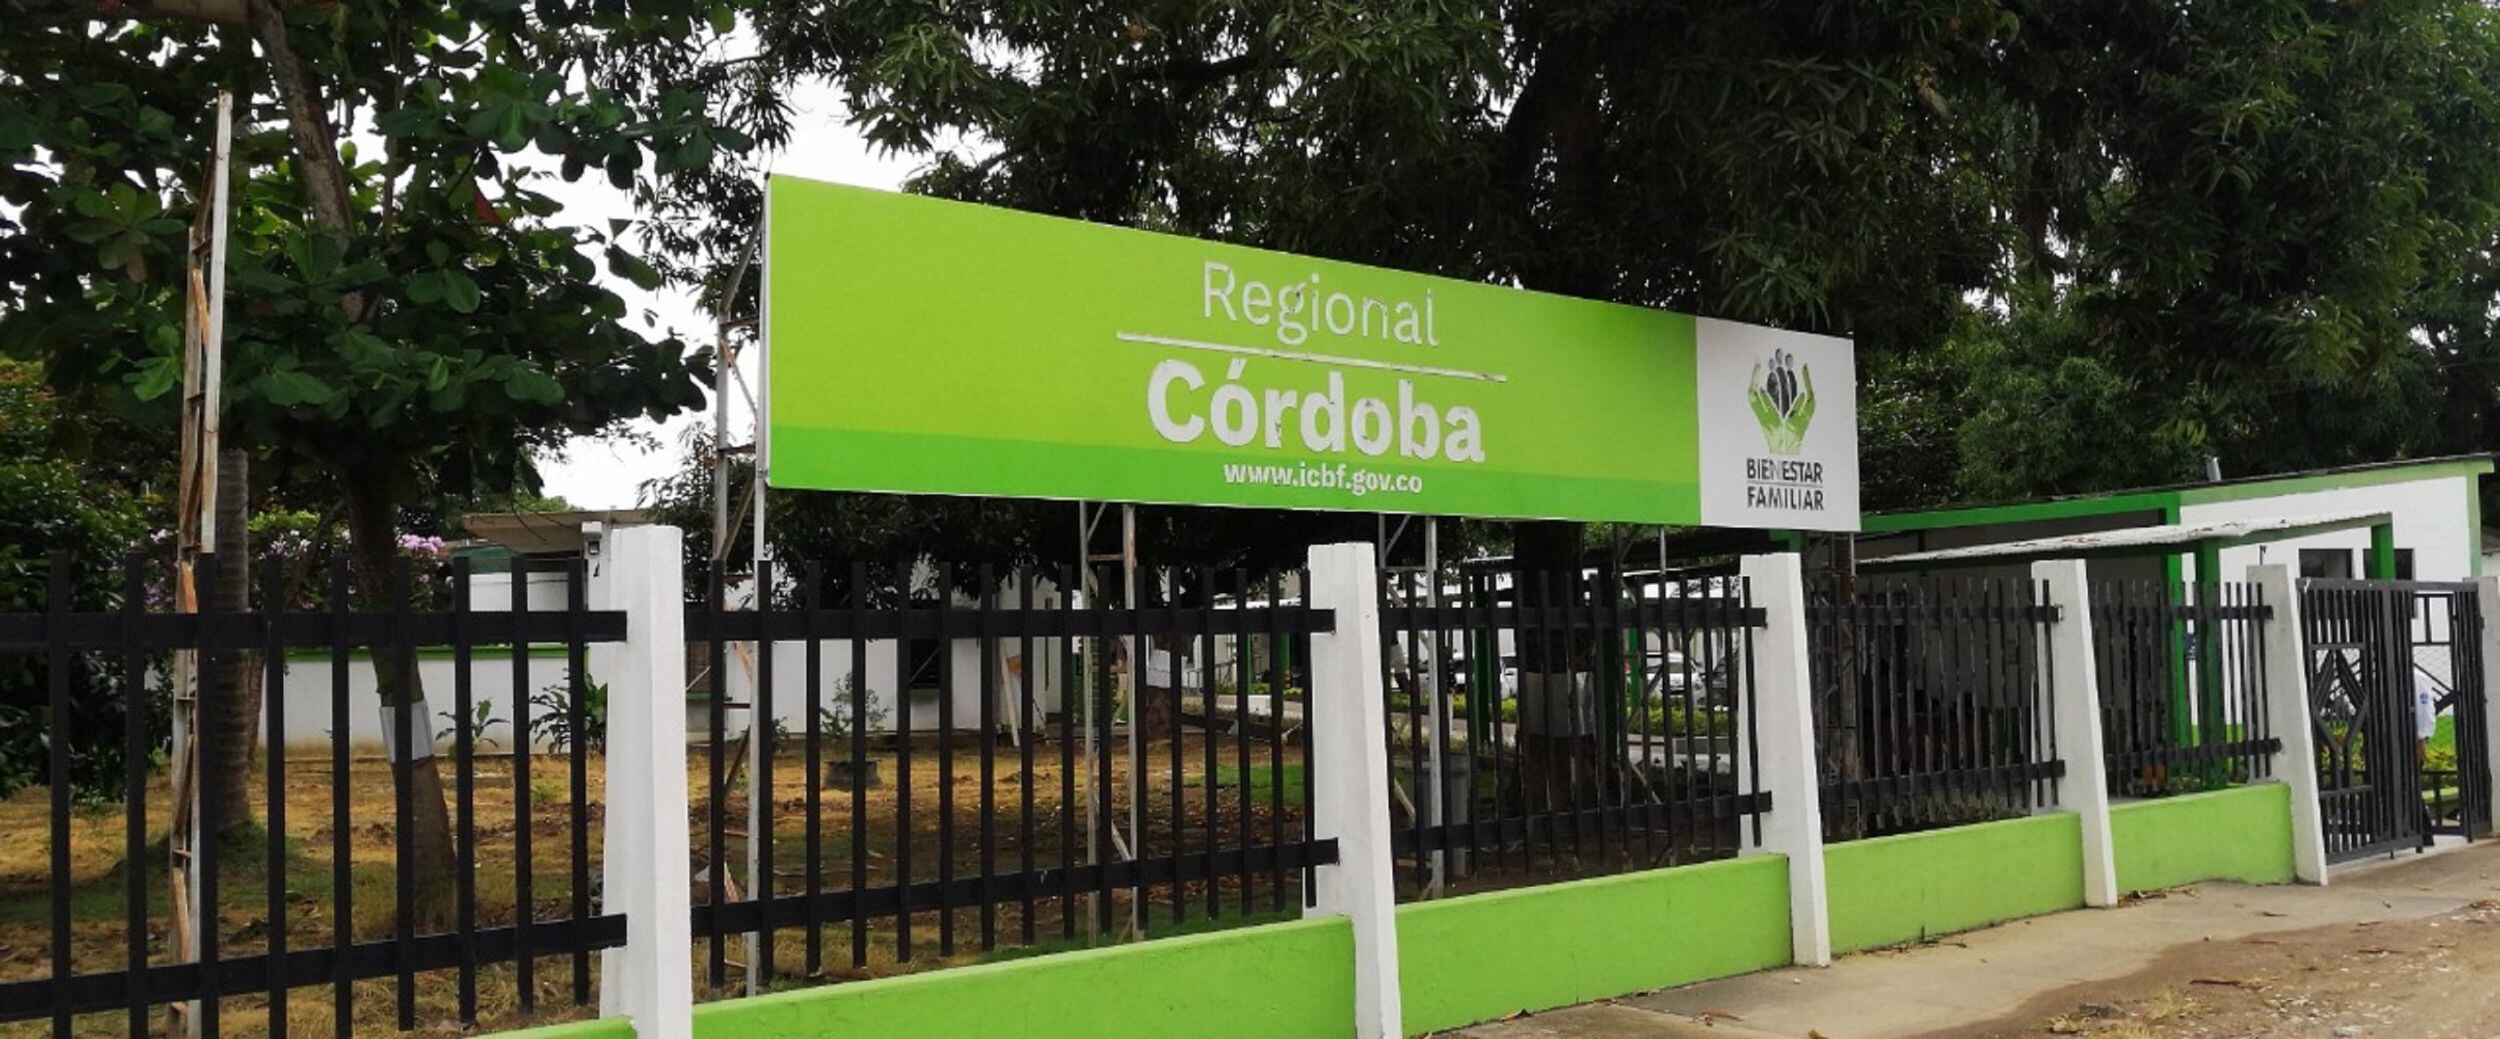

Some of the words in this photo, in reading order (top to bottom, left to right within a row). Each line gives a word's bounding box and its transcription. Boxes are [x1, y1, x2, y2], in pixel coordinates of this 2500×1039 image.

[1203, 261, 1440, 346] Regional
[1147, 358, 1486, 463] Córdoba
[1223, 463, 1422, 496] www.icbf.gov.co
[1746, 458, 1824, 483] BIENESTAR
[1746, 486, 1825, 511] FAMILIAR
